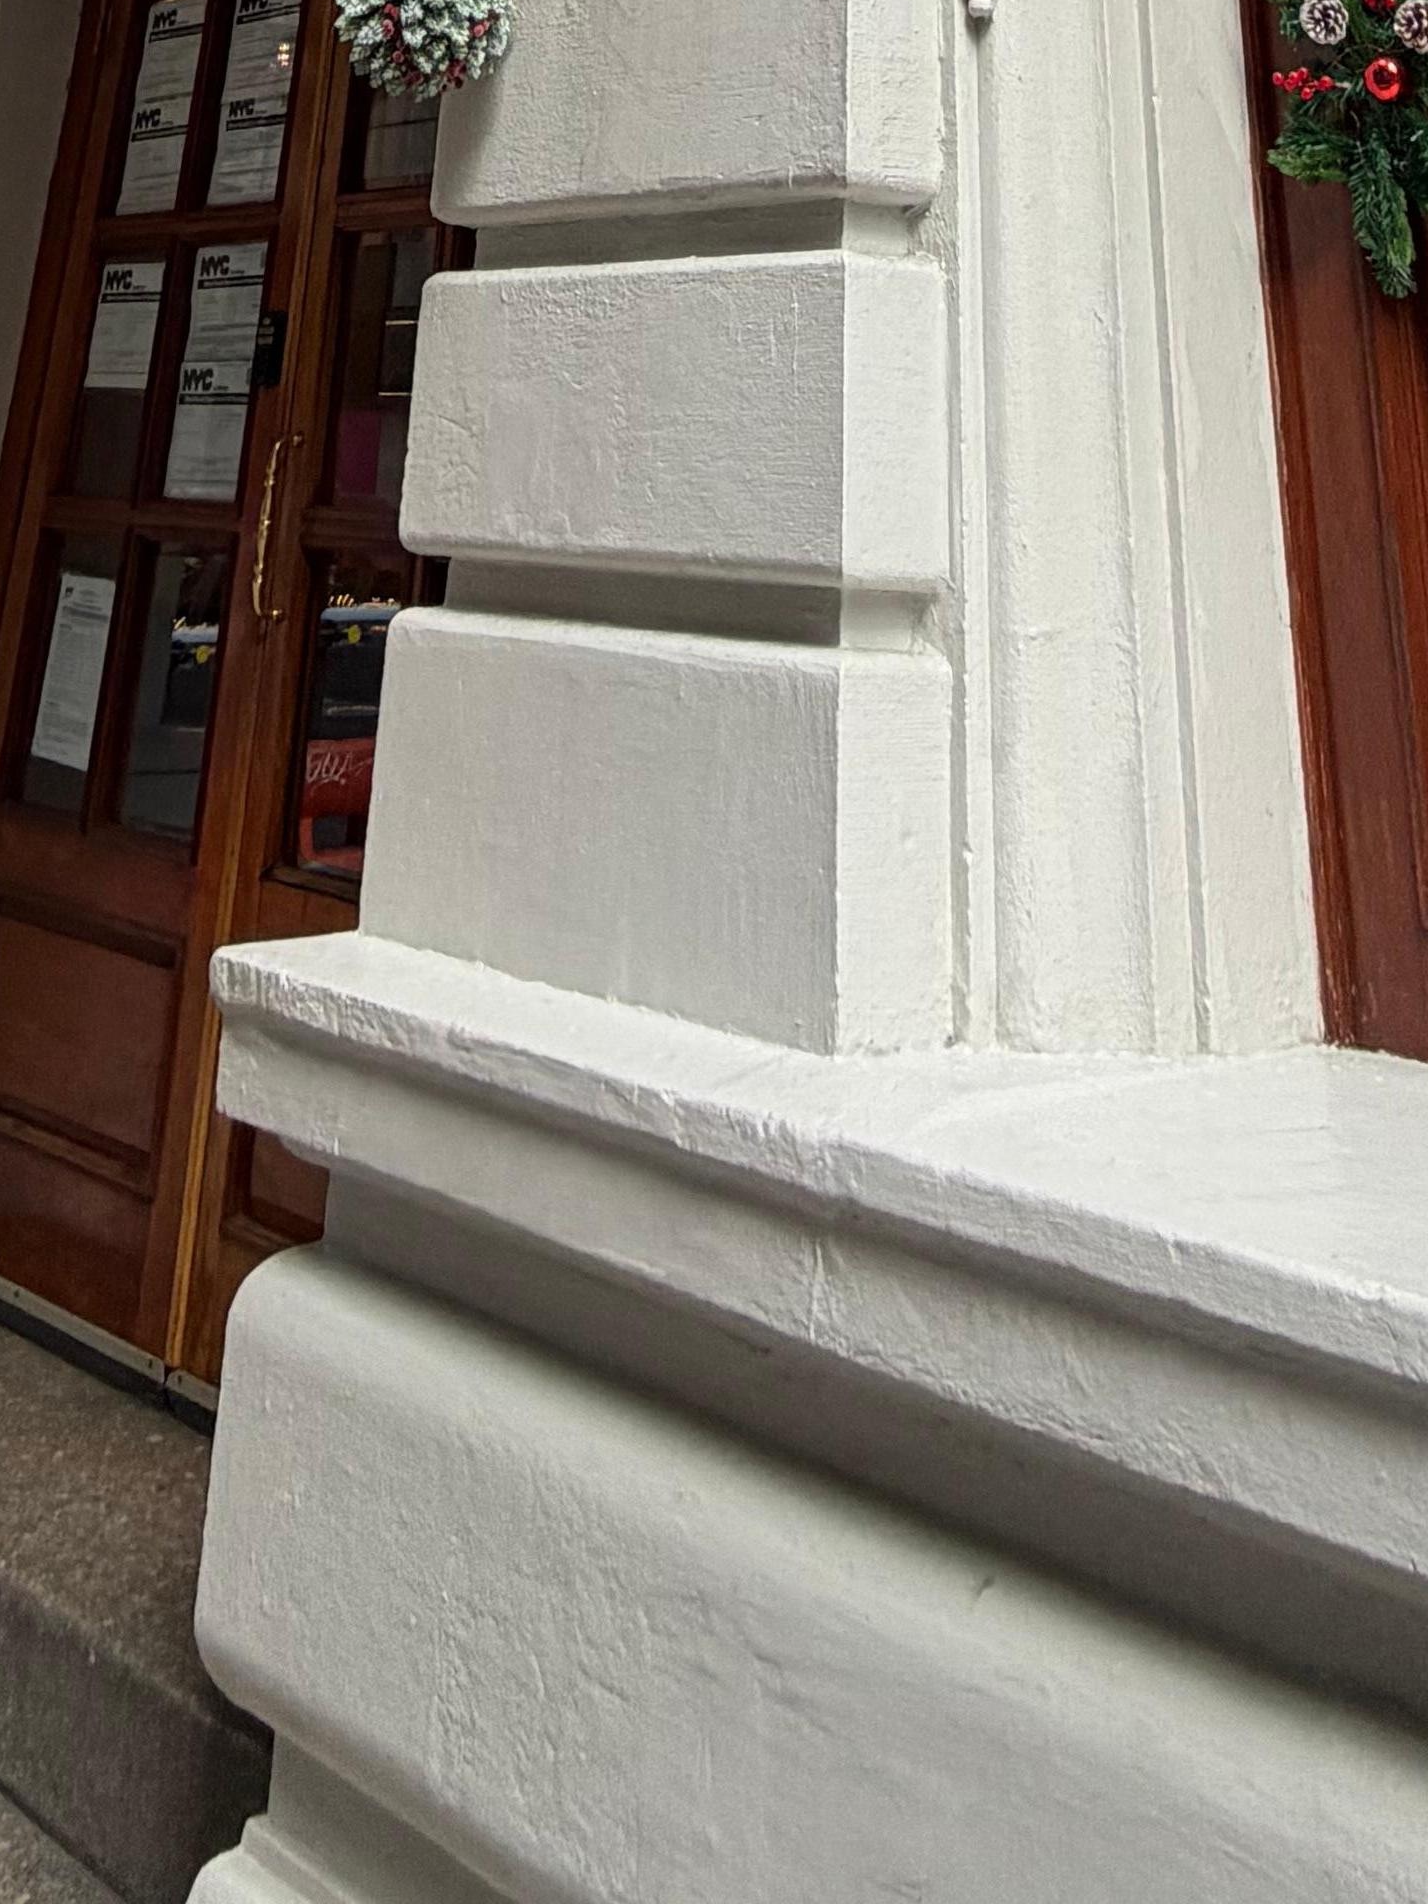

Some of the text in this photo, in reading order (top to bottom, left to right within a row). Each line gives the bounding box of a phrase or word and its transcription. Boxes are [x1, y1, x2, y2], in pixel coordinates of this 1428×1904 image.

[152, 8, 178, 30] NYC
[134, 108, 161, 129] NYC
[229, 98, 256, 118] NYC
[200, 255, 231, 277] NYC
[104, 269, 134, 291] NYC
[182, 368, 215, 392] NYC
